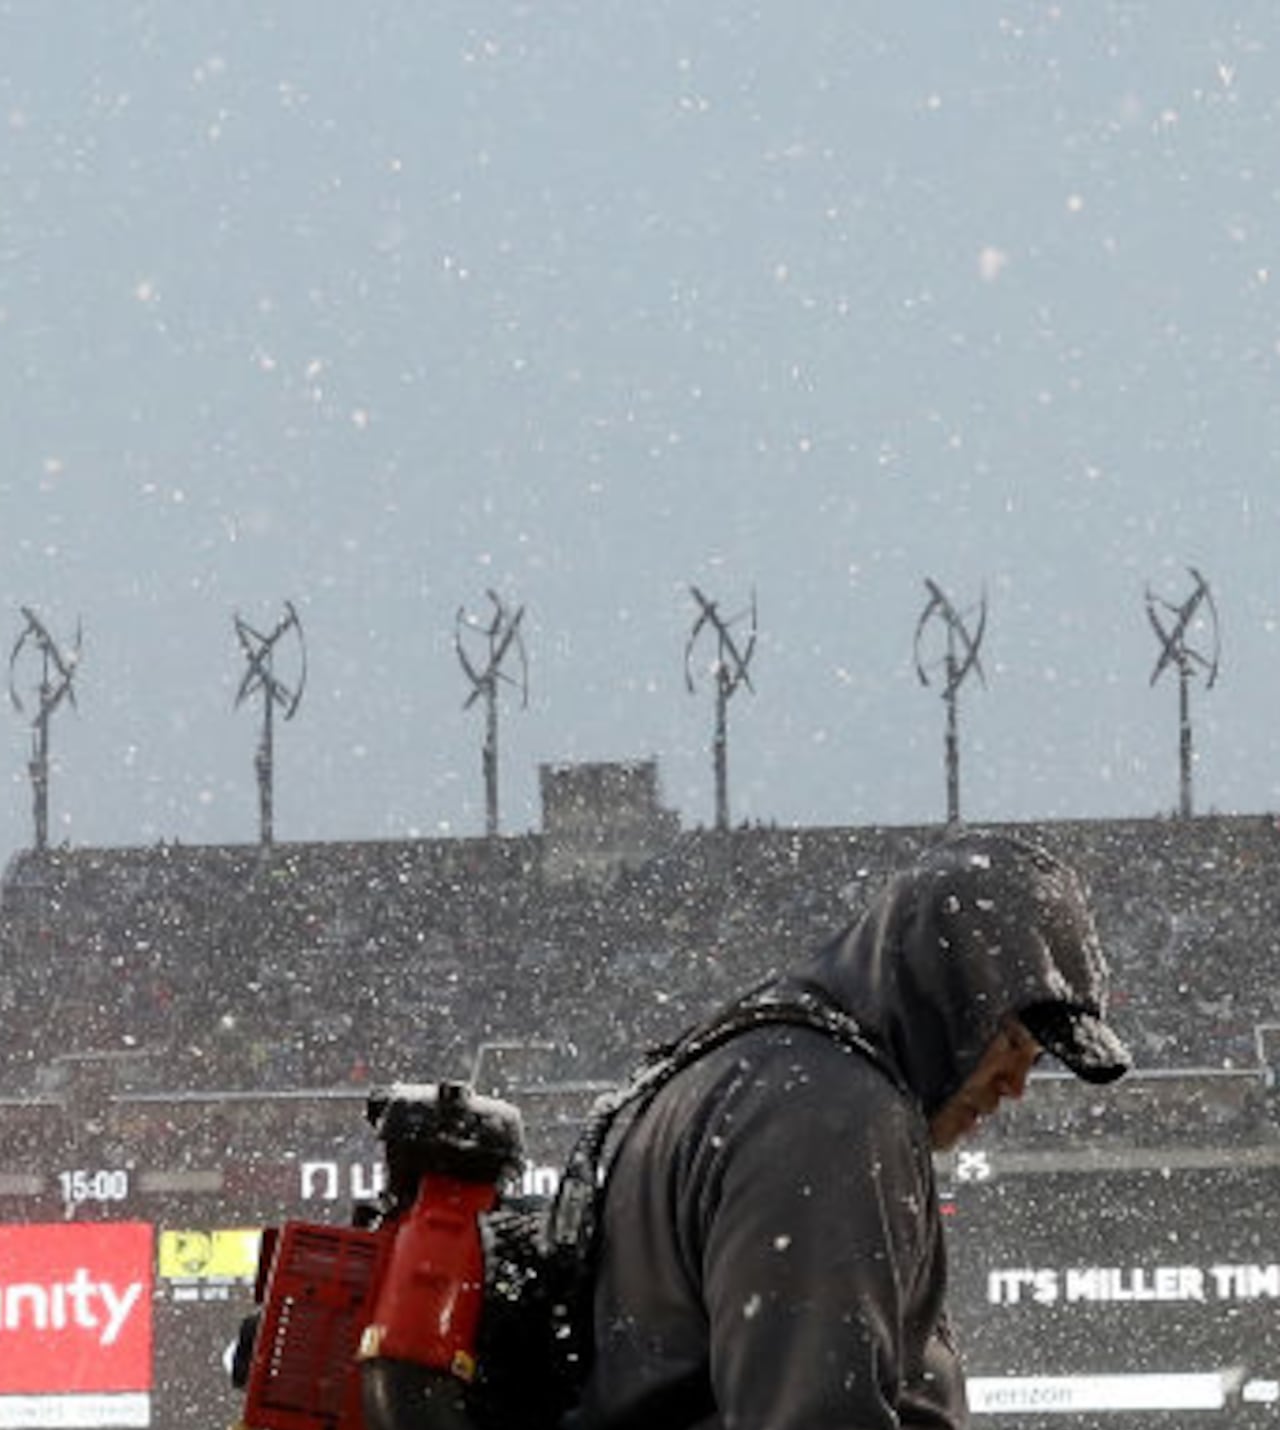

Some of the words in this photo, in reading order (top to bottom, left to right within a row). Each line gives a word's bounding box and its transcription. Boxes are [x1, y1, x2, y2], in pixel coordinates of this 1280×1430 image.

[58, 1170, 128, 1200] 15:00
[988, 1267, 1058, 1304] IT'S
[1066, 1266, 1205, 1303] MILLER
